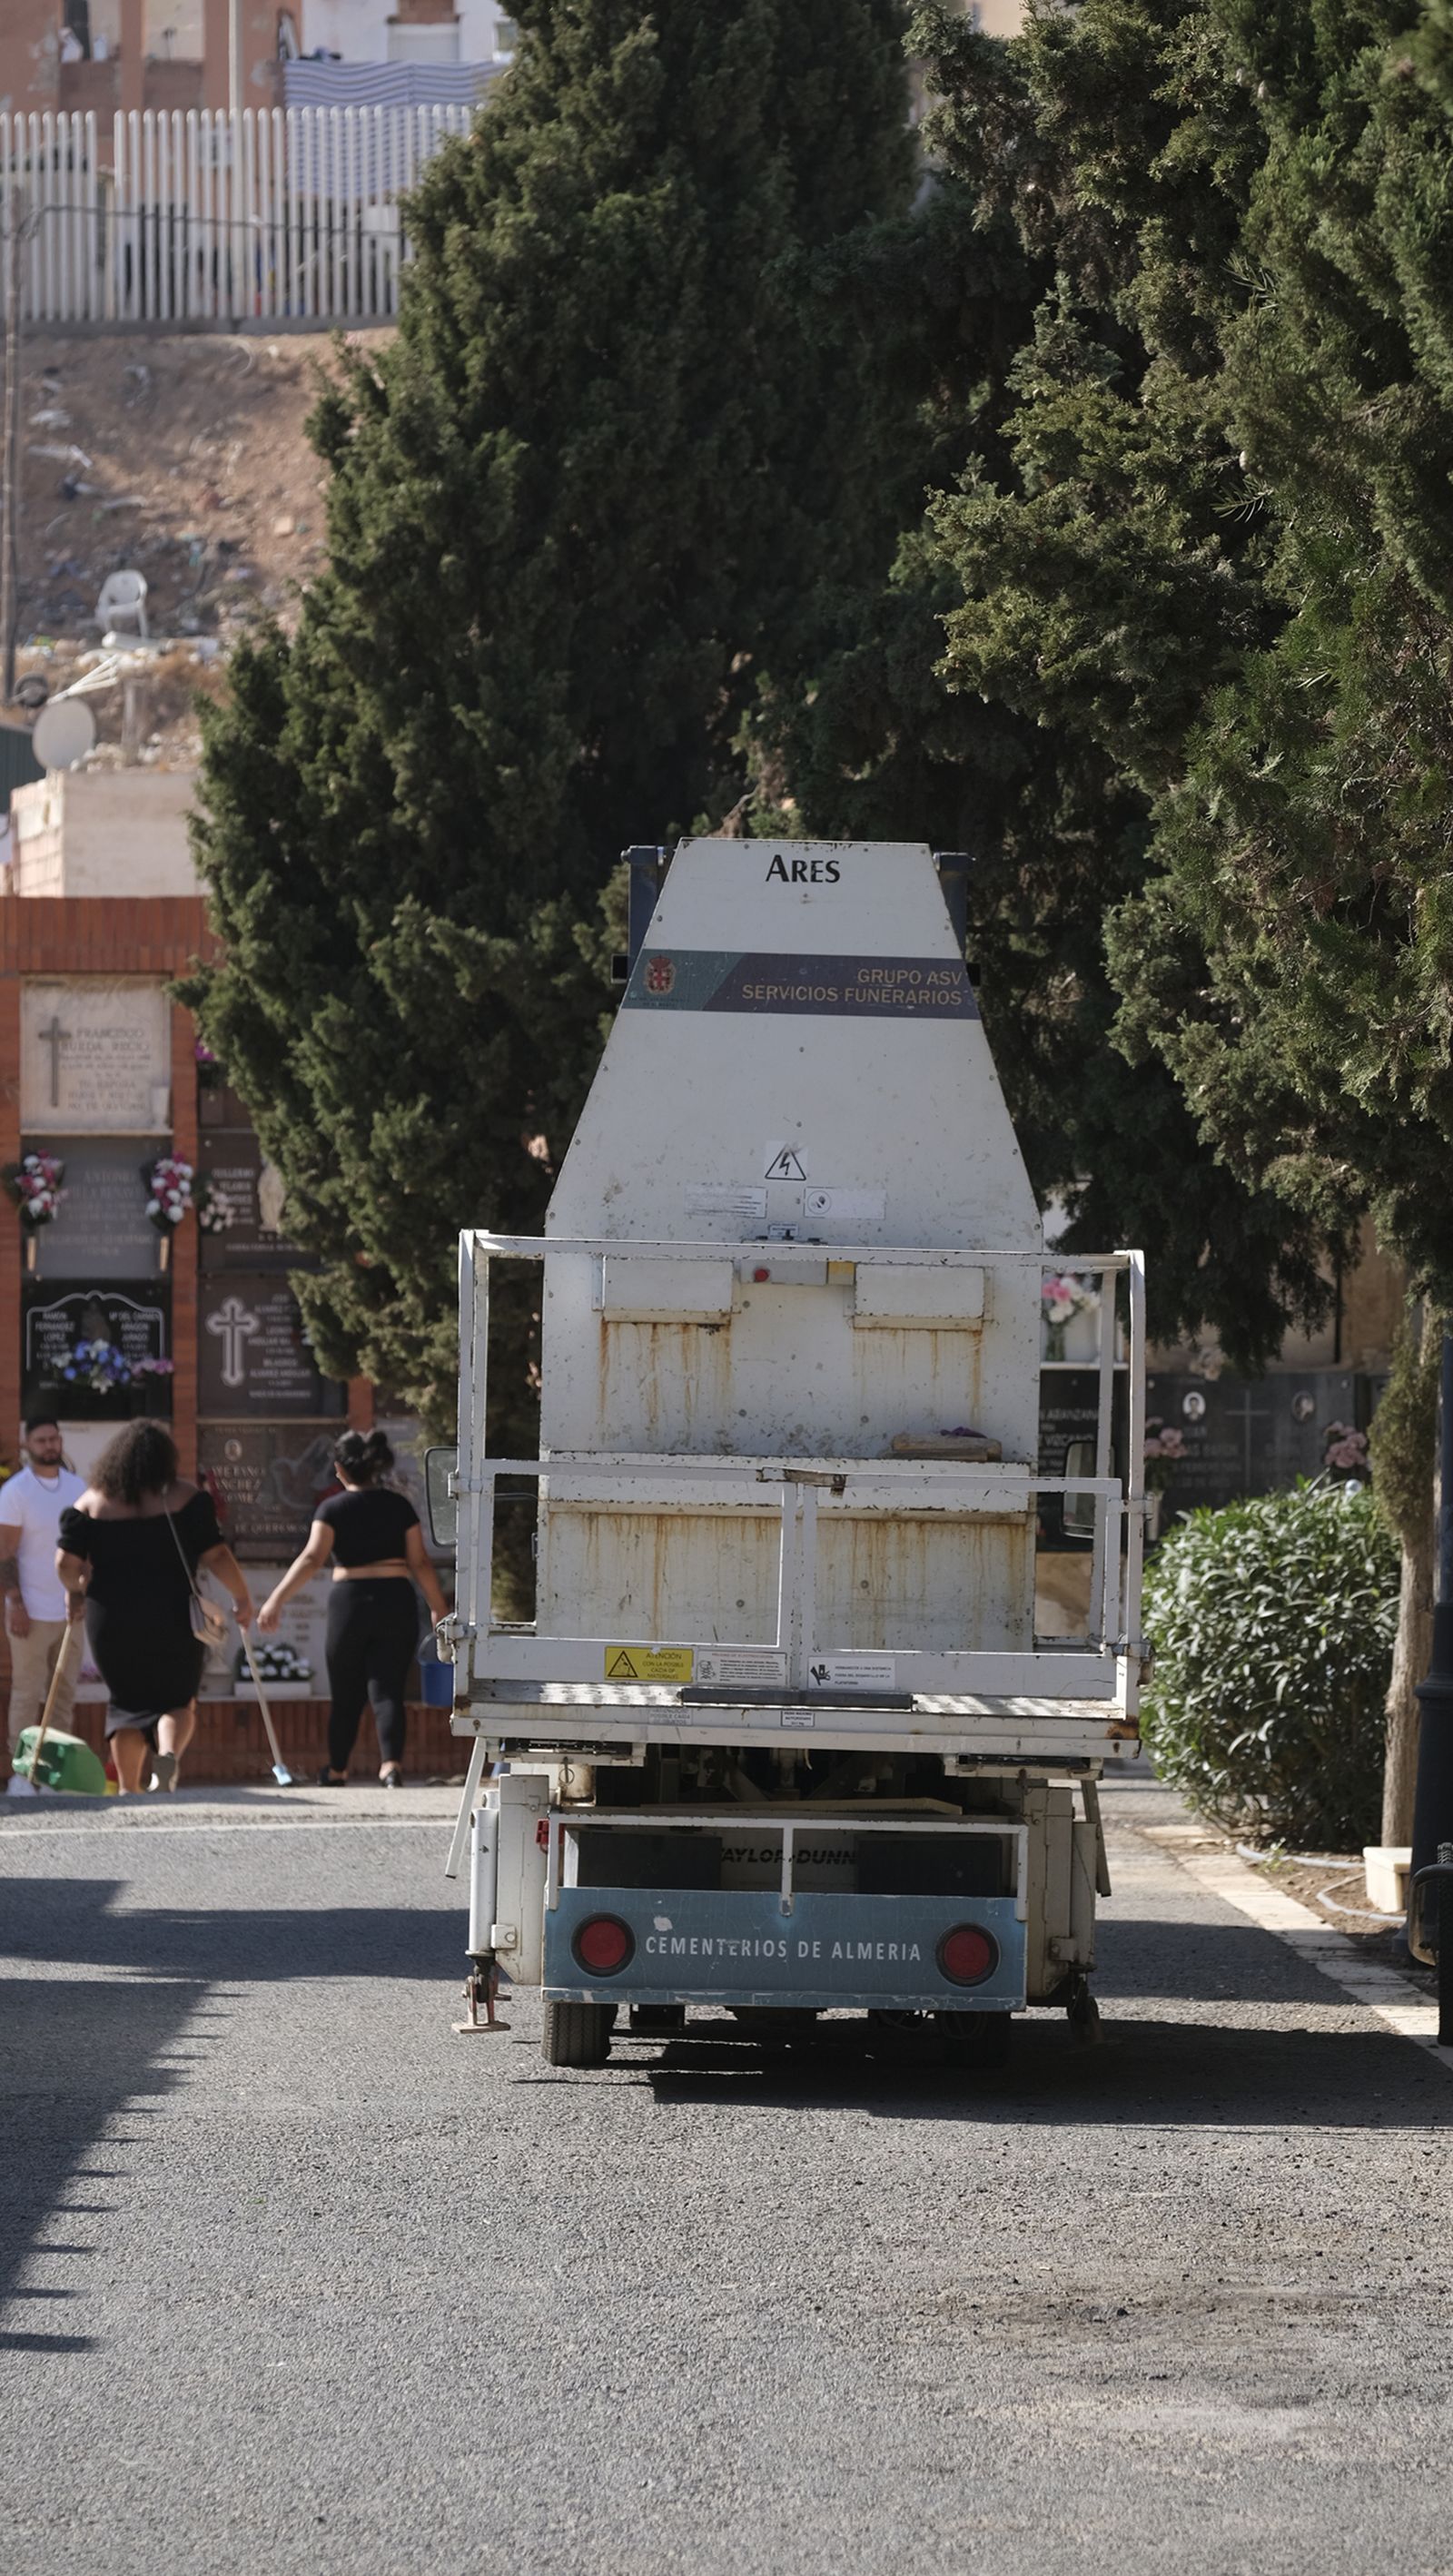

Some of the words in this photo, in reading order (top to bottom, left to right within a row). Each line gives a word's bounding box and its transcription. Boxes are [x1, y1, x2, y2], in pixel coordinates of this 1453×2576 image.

[766, 854, 841, 883] ARES
[857, 968, 922, 985] GRUPO
[926, 971, 963, 986] ASV
[742, 984, 838, 1002] SERVICIOS
[845, 987, 963, 1006] FUNERARIOS
[646, 1936, 787, 1958] CEMENTERIOS
[798, 1940, 821, 1959] DE
[832, 1941, 922, 1961] ALMERIA
